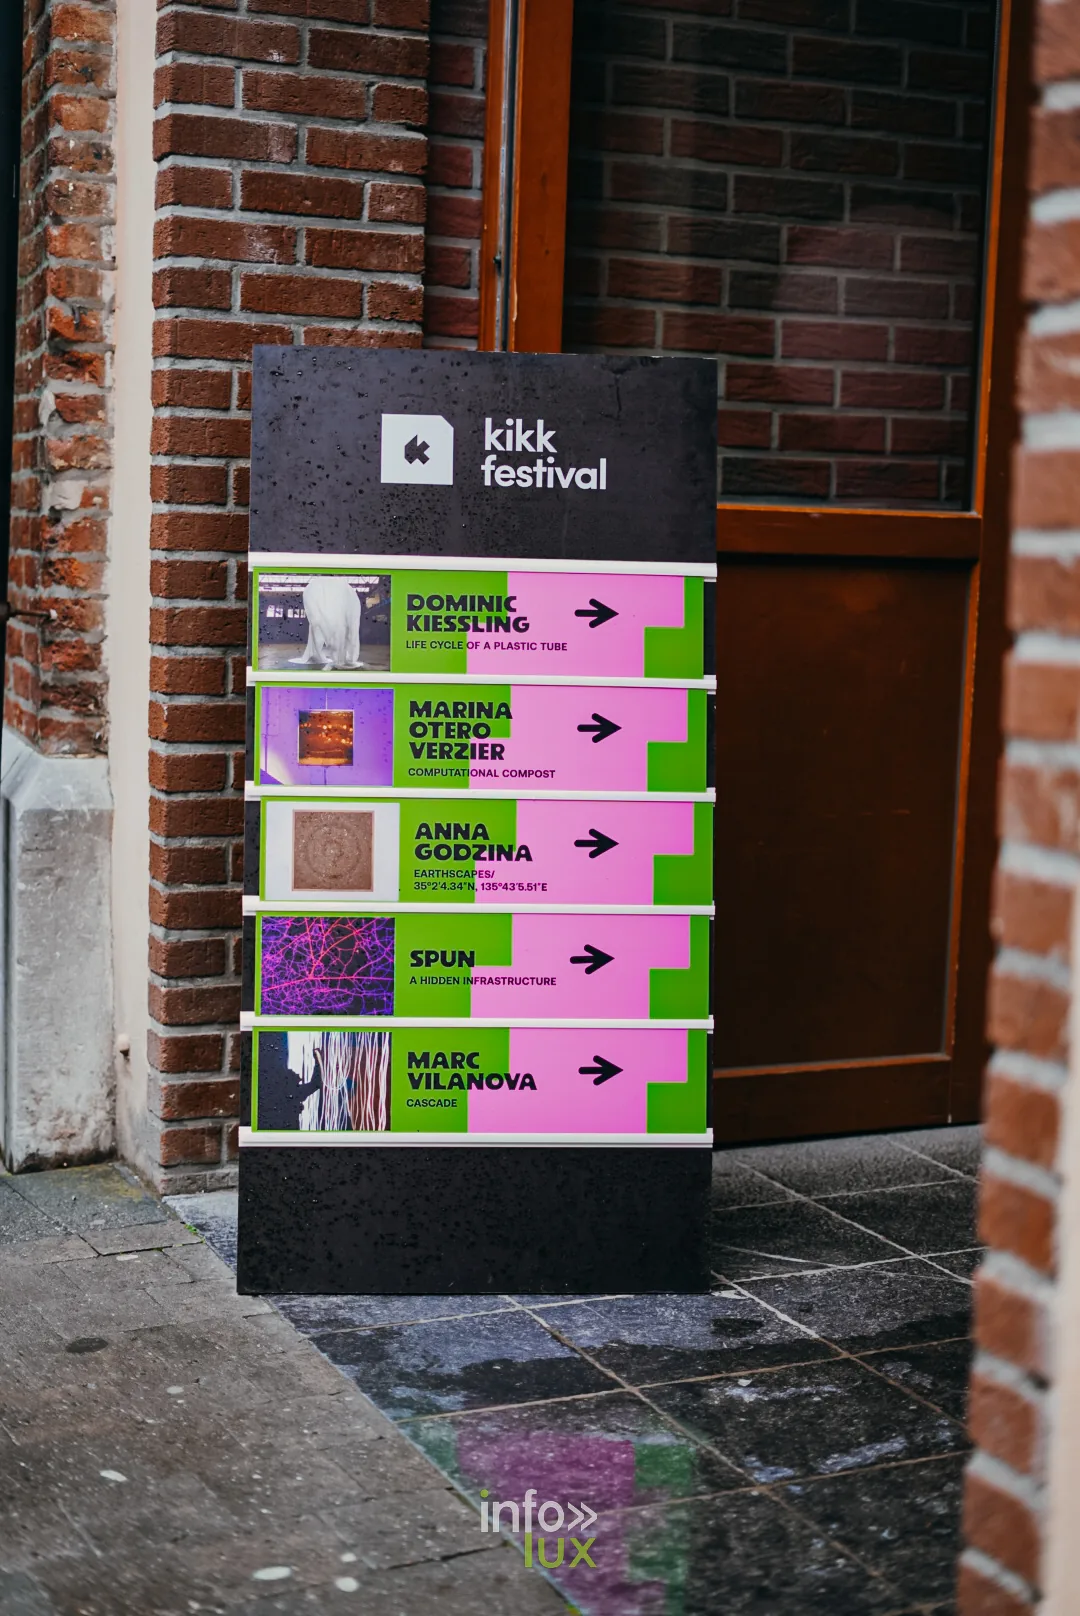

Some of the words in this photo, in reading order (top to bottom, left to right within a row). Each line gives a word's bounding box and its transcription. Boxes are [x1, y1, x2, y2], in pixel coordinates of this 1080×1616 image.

[484, 417, 558, 453] kikk
[481, 454, 607, 490] festival
[406, 594, 517, 613] DOMINIC
[406, 614, 530, 633] KIESSLING
[405, 640, 427, 649] LIFE
[429, 641, 464, 650] CYCLE
[466, 641, 481, 650] OF
[483, 642, 491, 650] A
[494, 642, 538, 651] PLASTIC
[540, 642, 568, 651] TUBE
[409, 700, 513, 719] MARINA
[409, 721, 491, 739] OTERO
[408, 742, 505, 760] VERZIER
[408, 768, 500, 778] COMPUTATIONAL
[502, 769, 556, 778] COMPOST
[415, 822, 490, 840] ANNA
[414, 843, 533, 862] GODZINA
[413, 869, 496, 879] EARTHSCAPES/
[410, 949, 475, 968] SPUN
[409, 976, 418, 985] A
[420, 976, 460, 985] HIDDEN
[462, 976, 557, 986] INFRASTRUCTURE
[407, 1051, 480, 1070] MARC
[407, 1072, 538, 1091] VILANOVA
[406, 1098, 458, 1108] CASCADE
